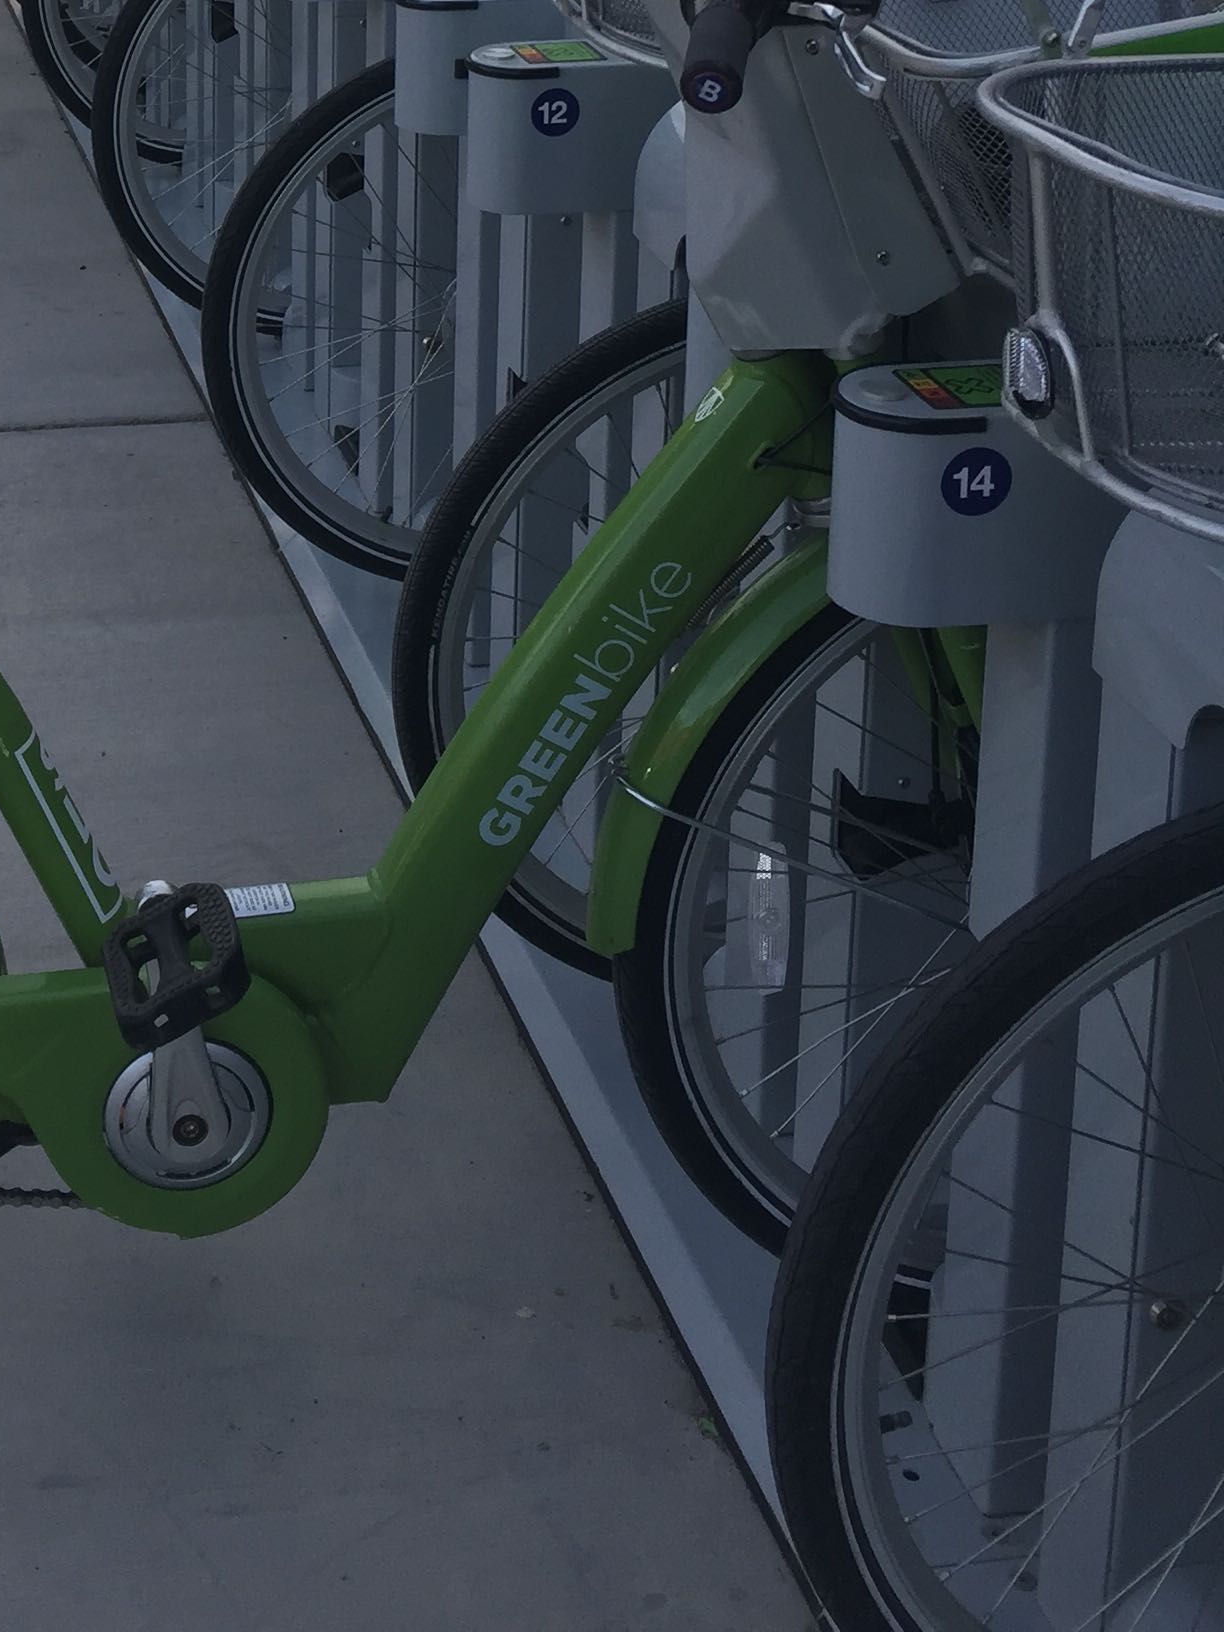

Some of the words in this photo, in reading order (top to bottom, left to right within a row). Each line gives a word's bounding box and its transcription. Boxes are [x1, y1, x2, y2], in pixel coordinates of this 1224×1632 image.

[698, 79, 723, 103] B
[538, 100, 567, 124] 12
[952, 465, 995, 499] 14
[478, 560, 692, 847] GREENbike
